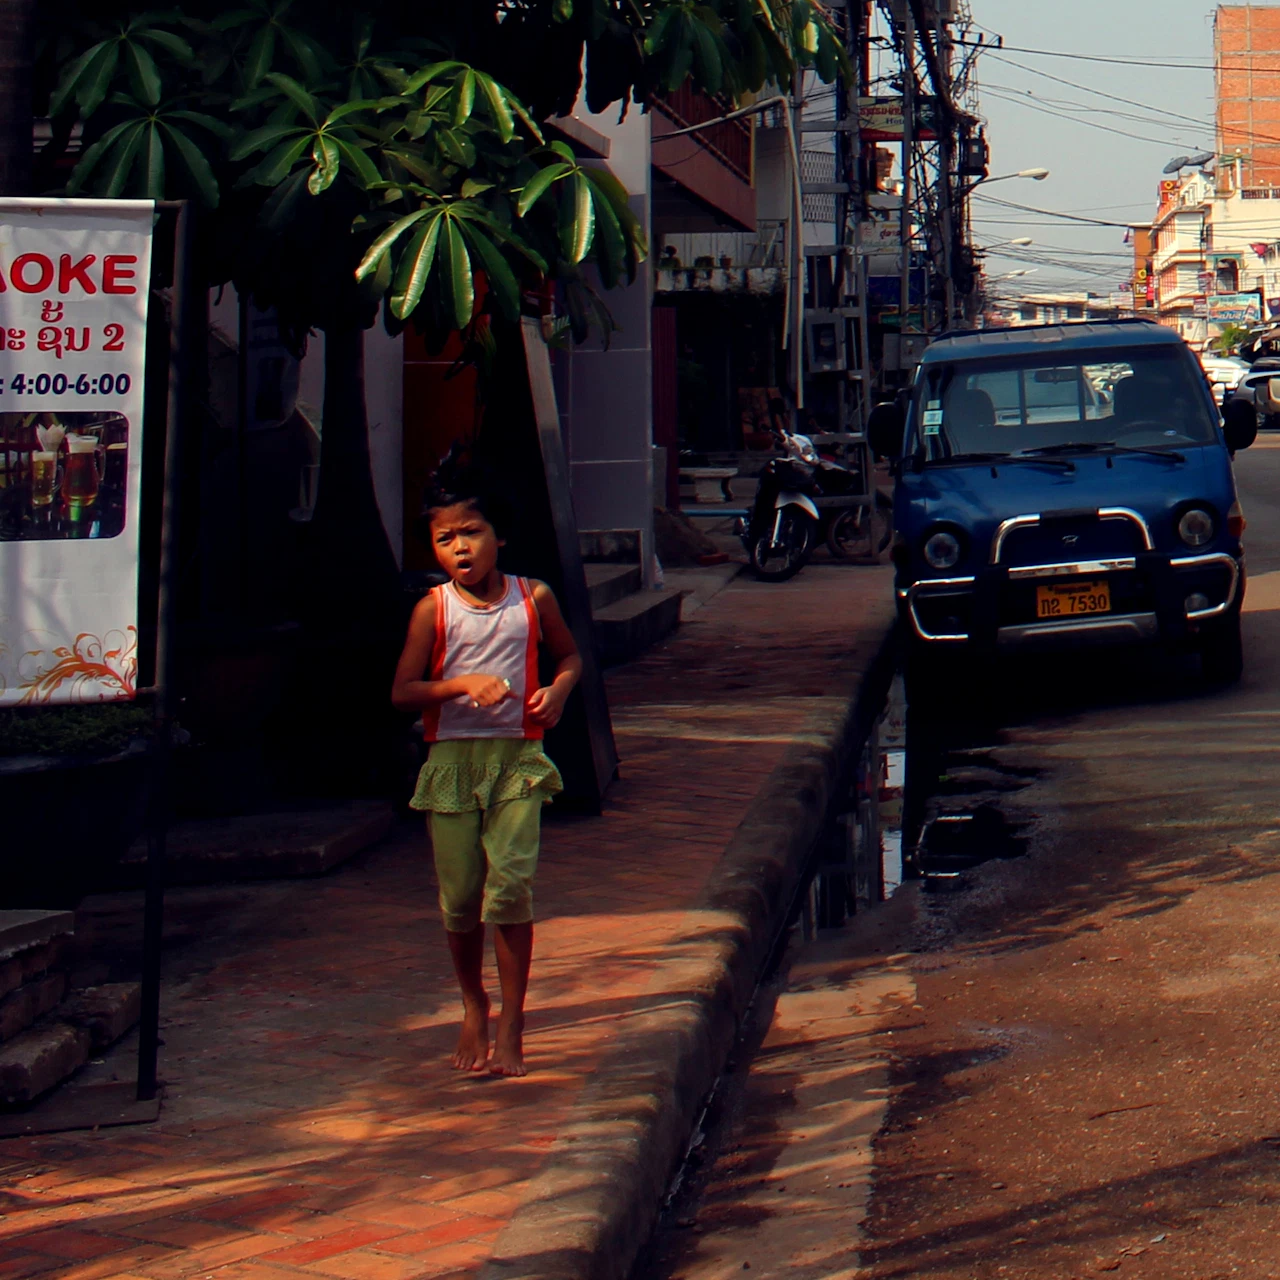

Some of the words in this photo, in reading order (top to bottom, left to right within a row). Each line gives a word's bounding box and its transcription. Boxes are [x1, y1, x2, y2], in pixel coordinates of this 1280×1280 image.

[102, 323, 125, 352] 2
[10, 373, 131, 395] 4:00-6:00
[1068, 593, 1107, 612] 7530
